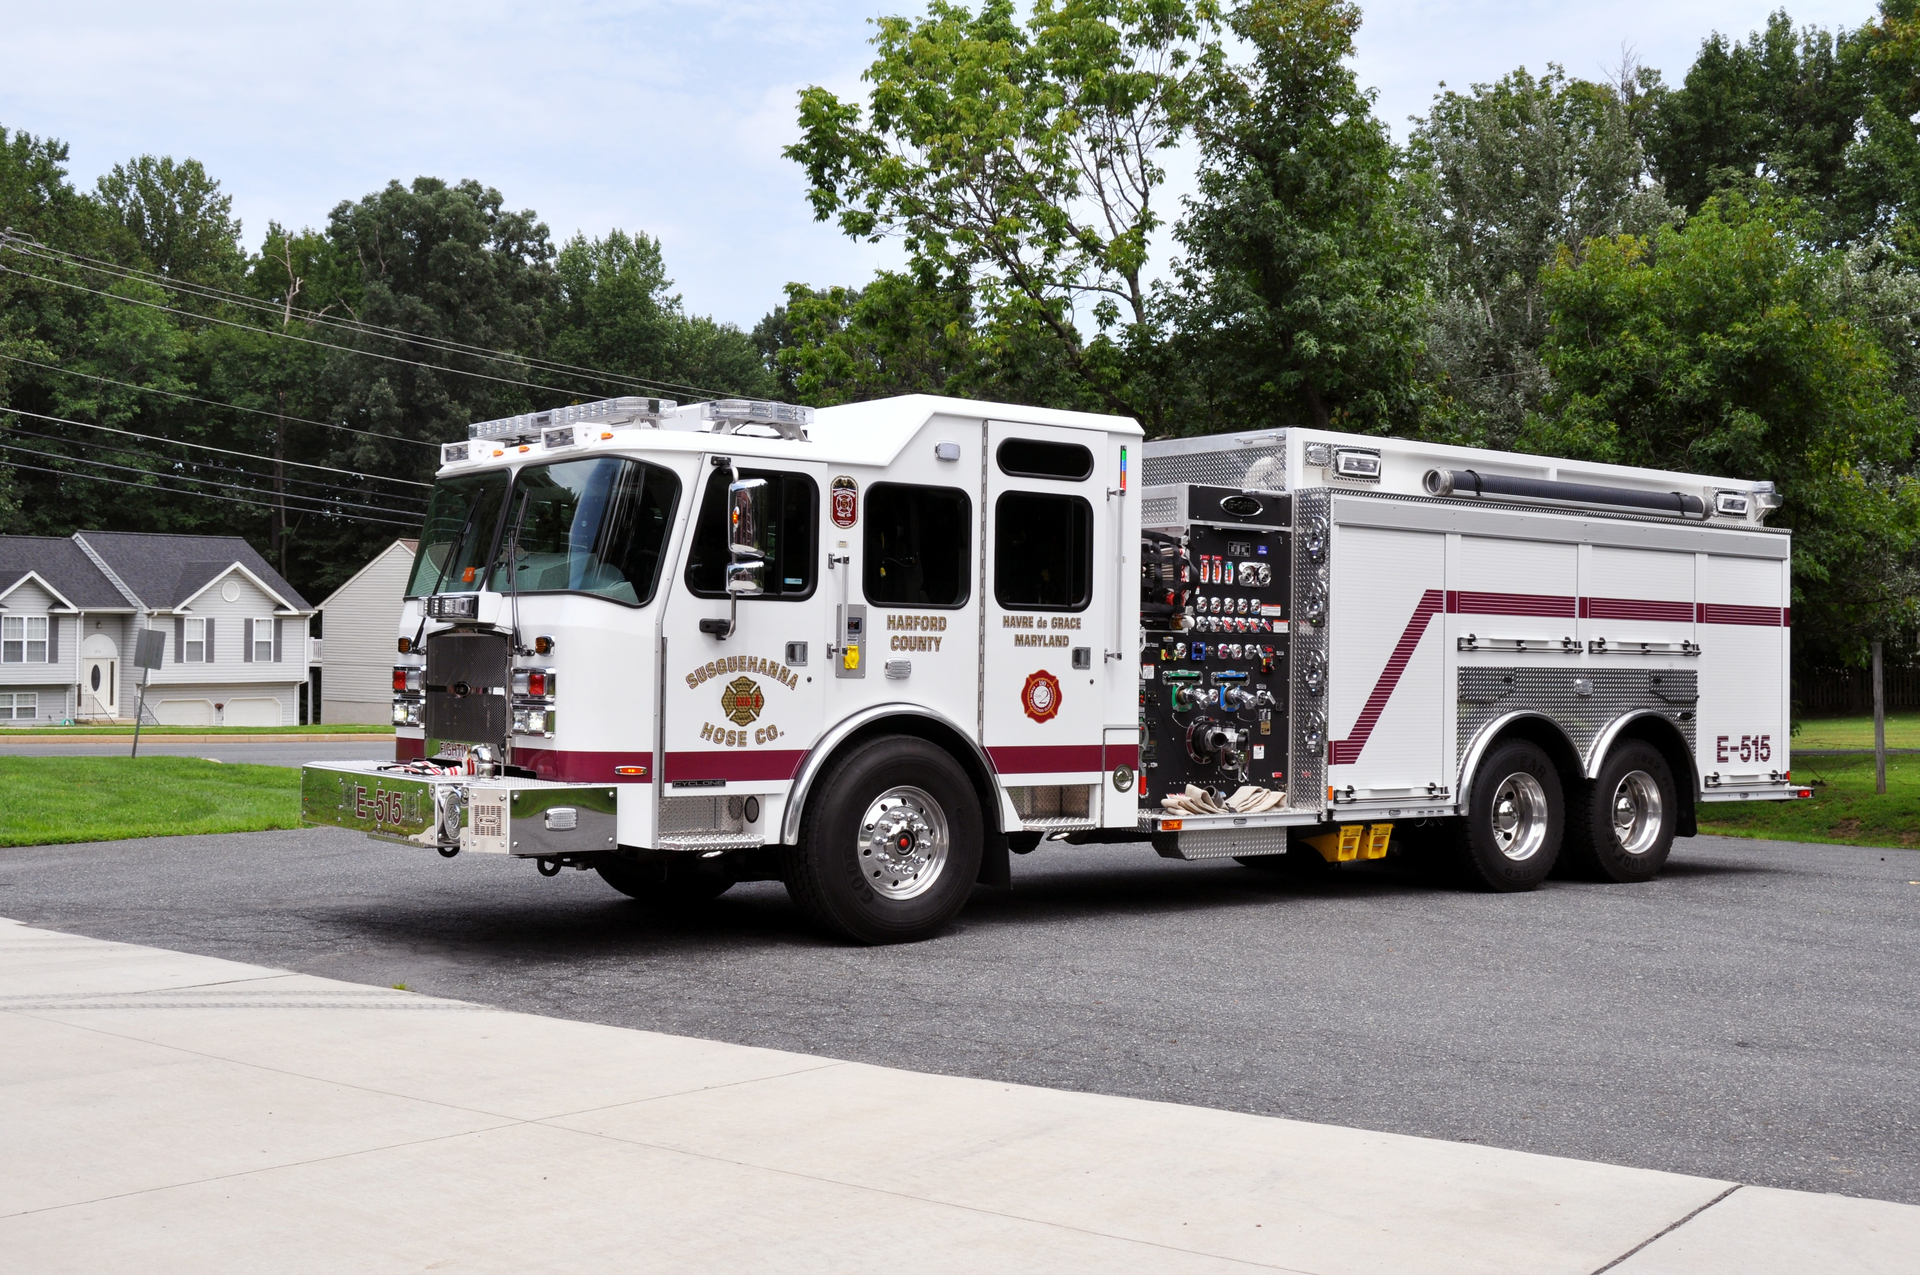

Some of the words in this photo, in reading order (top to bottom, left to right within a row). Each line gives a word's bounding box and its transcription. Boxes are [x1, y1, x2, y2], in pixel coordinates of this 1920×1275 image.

[887, 615, 947, 632] HARFORD
[1003, 615, 1034, 630] HAVRE
[1037, 616, 1048, 630] de
[1051, 616, 1081, 630] GRACE
[891, 635, 942, 652] COUNTY
[1014, 634, 1070, 648] MARYLAND
[685, 655, 799, 691] SUSQUEHANNA
[736, 696, 751, 707] 515
[700, 721, 748, 747] HOSE
[755, 724, 785, 745] CO.
[1716, 734, 1771, 763] E-515
[356, 786, 403, 825] E-515
